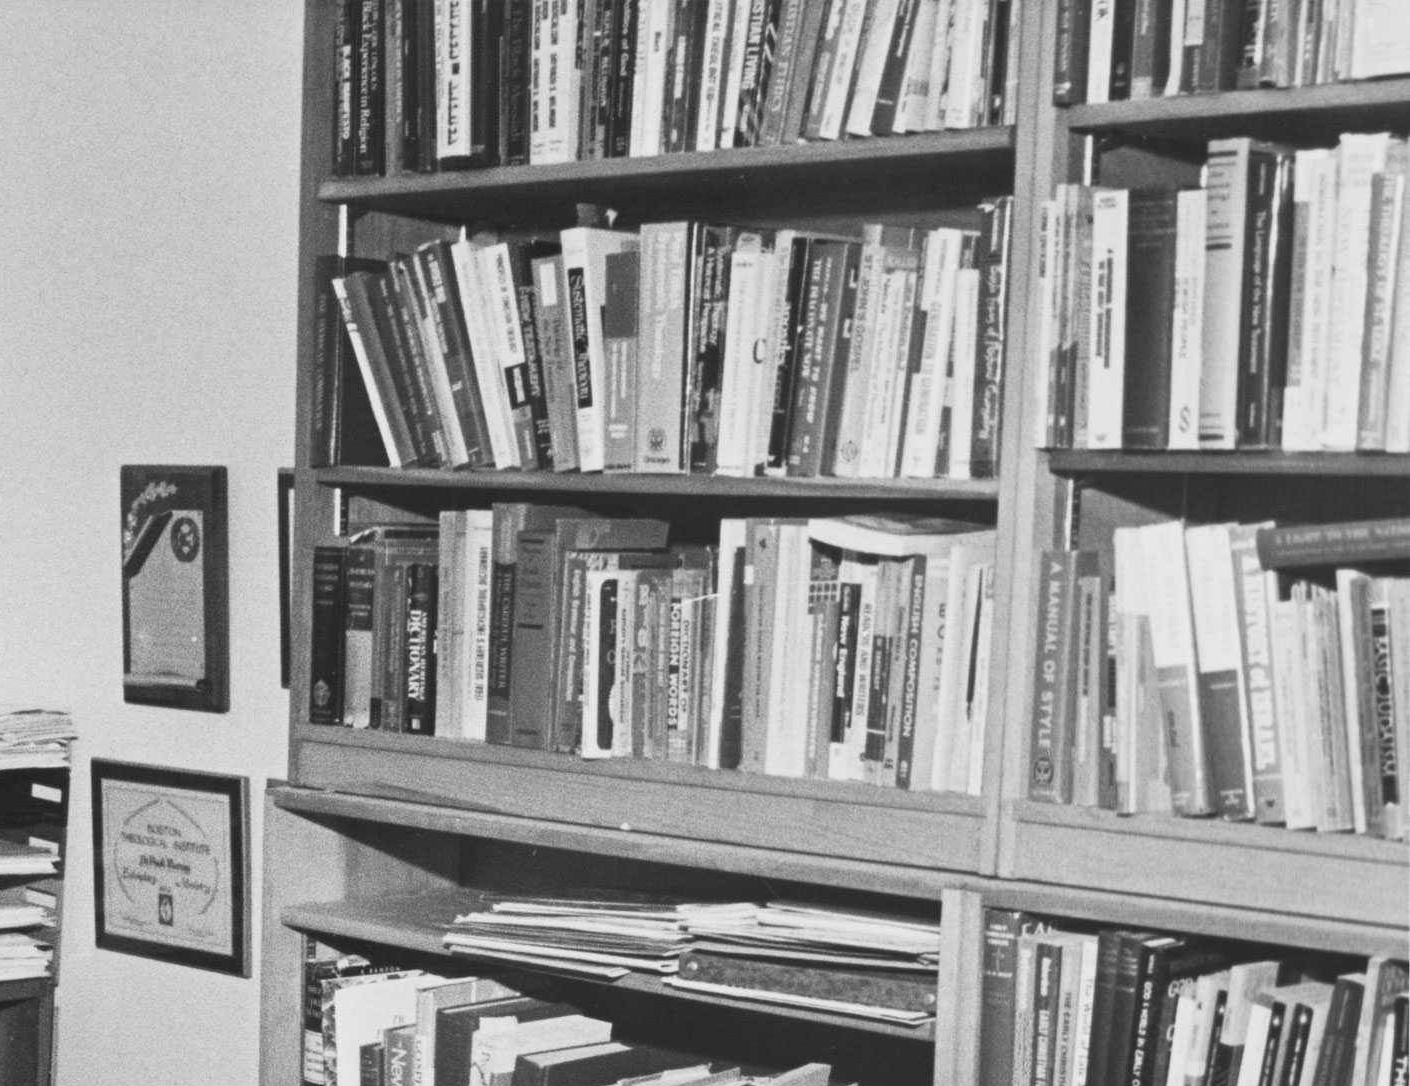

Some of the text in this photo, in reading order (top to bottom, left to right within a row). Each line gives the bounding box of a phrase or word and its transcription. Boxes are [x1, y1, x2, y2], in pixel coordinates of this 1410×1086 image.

[359, 33, 373, 94] Experience
[741, 46, 760, 91] LIVING
[771, 61, 789, 113] ETHICS
[358, 109, 371, 155] Religion
[811, 259, 824, 282] THE
[1247, 210, 1267, 375] The Language of the New Testament
[850, 324, 867, 375] GOSPEL
[501, 573, 512, 593] THE
[571, 570, 583, 597] English
[407, 609, 423, 701] DICTIONARY
[498, 647, 510, 691] WRITER
[667, 603, 681, 726] FOREIGN WORDS
[681, 619, 691, 694] DICTIONARY
[835, 615, 851, 699] New England
[901, 574, 924, 740] ENGLISH COMPOSITION
[1037, 561, 1063, 749] A MANUAL OF STYLE
[1243, 555, 1277, 771] A HISTORY of ISRAEL
[855, 674, 868, 718] WRITERS
[1378, 694, 1397, 777] JUDAISM
[1063, 991, 1073, 1009] THE
[1083, 976, 1096, 1000] The
[1141, 980, 1153, 1000] GOD
[1038, 1009, 1051, 1035] EARLY
[1060, 1011, 1072, 1044] EARLY
[1081, 1002, 1094, 1035] World
[1137, 1009, 1149, 1036] WORLD
[1036, 1036, 1050, 1079] CHRISTIAN
[1079, 1036, 1090, 1049] of
[1132, 1048, 1146, 1077] EARLY
[1136, 1036, 1147, 1048] IN
[1077, 1053, 1090, 1077] Late
